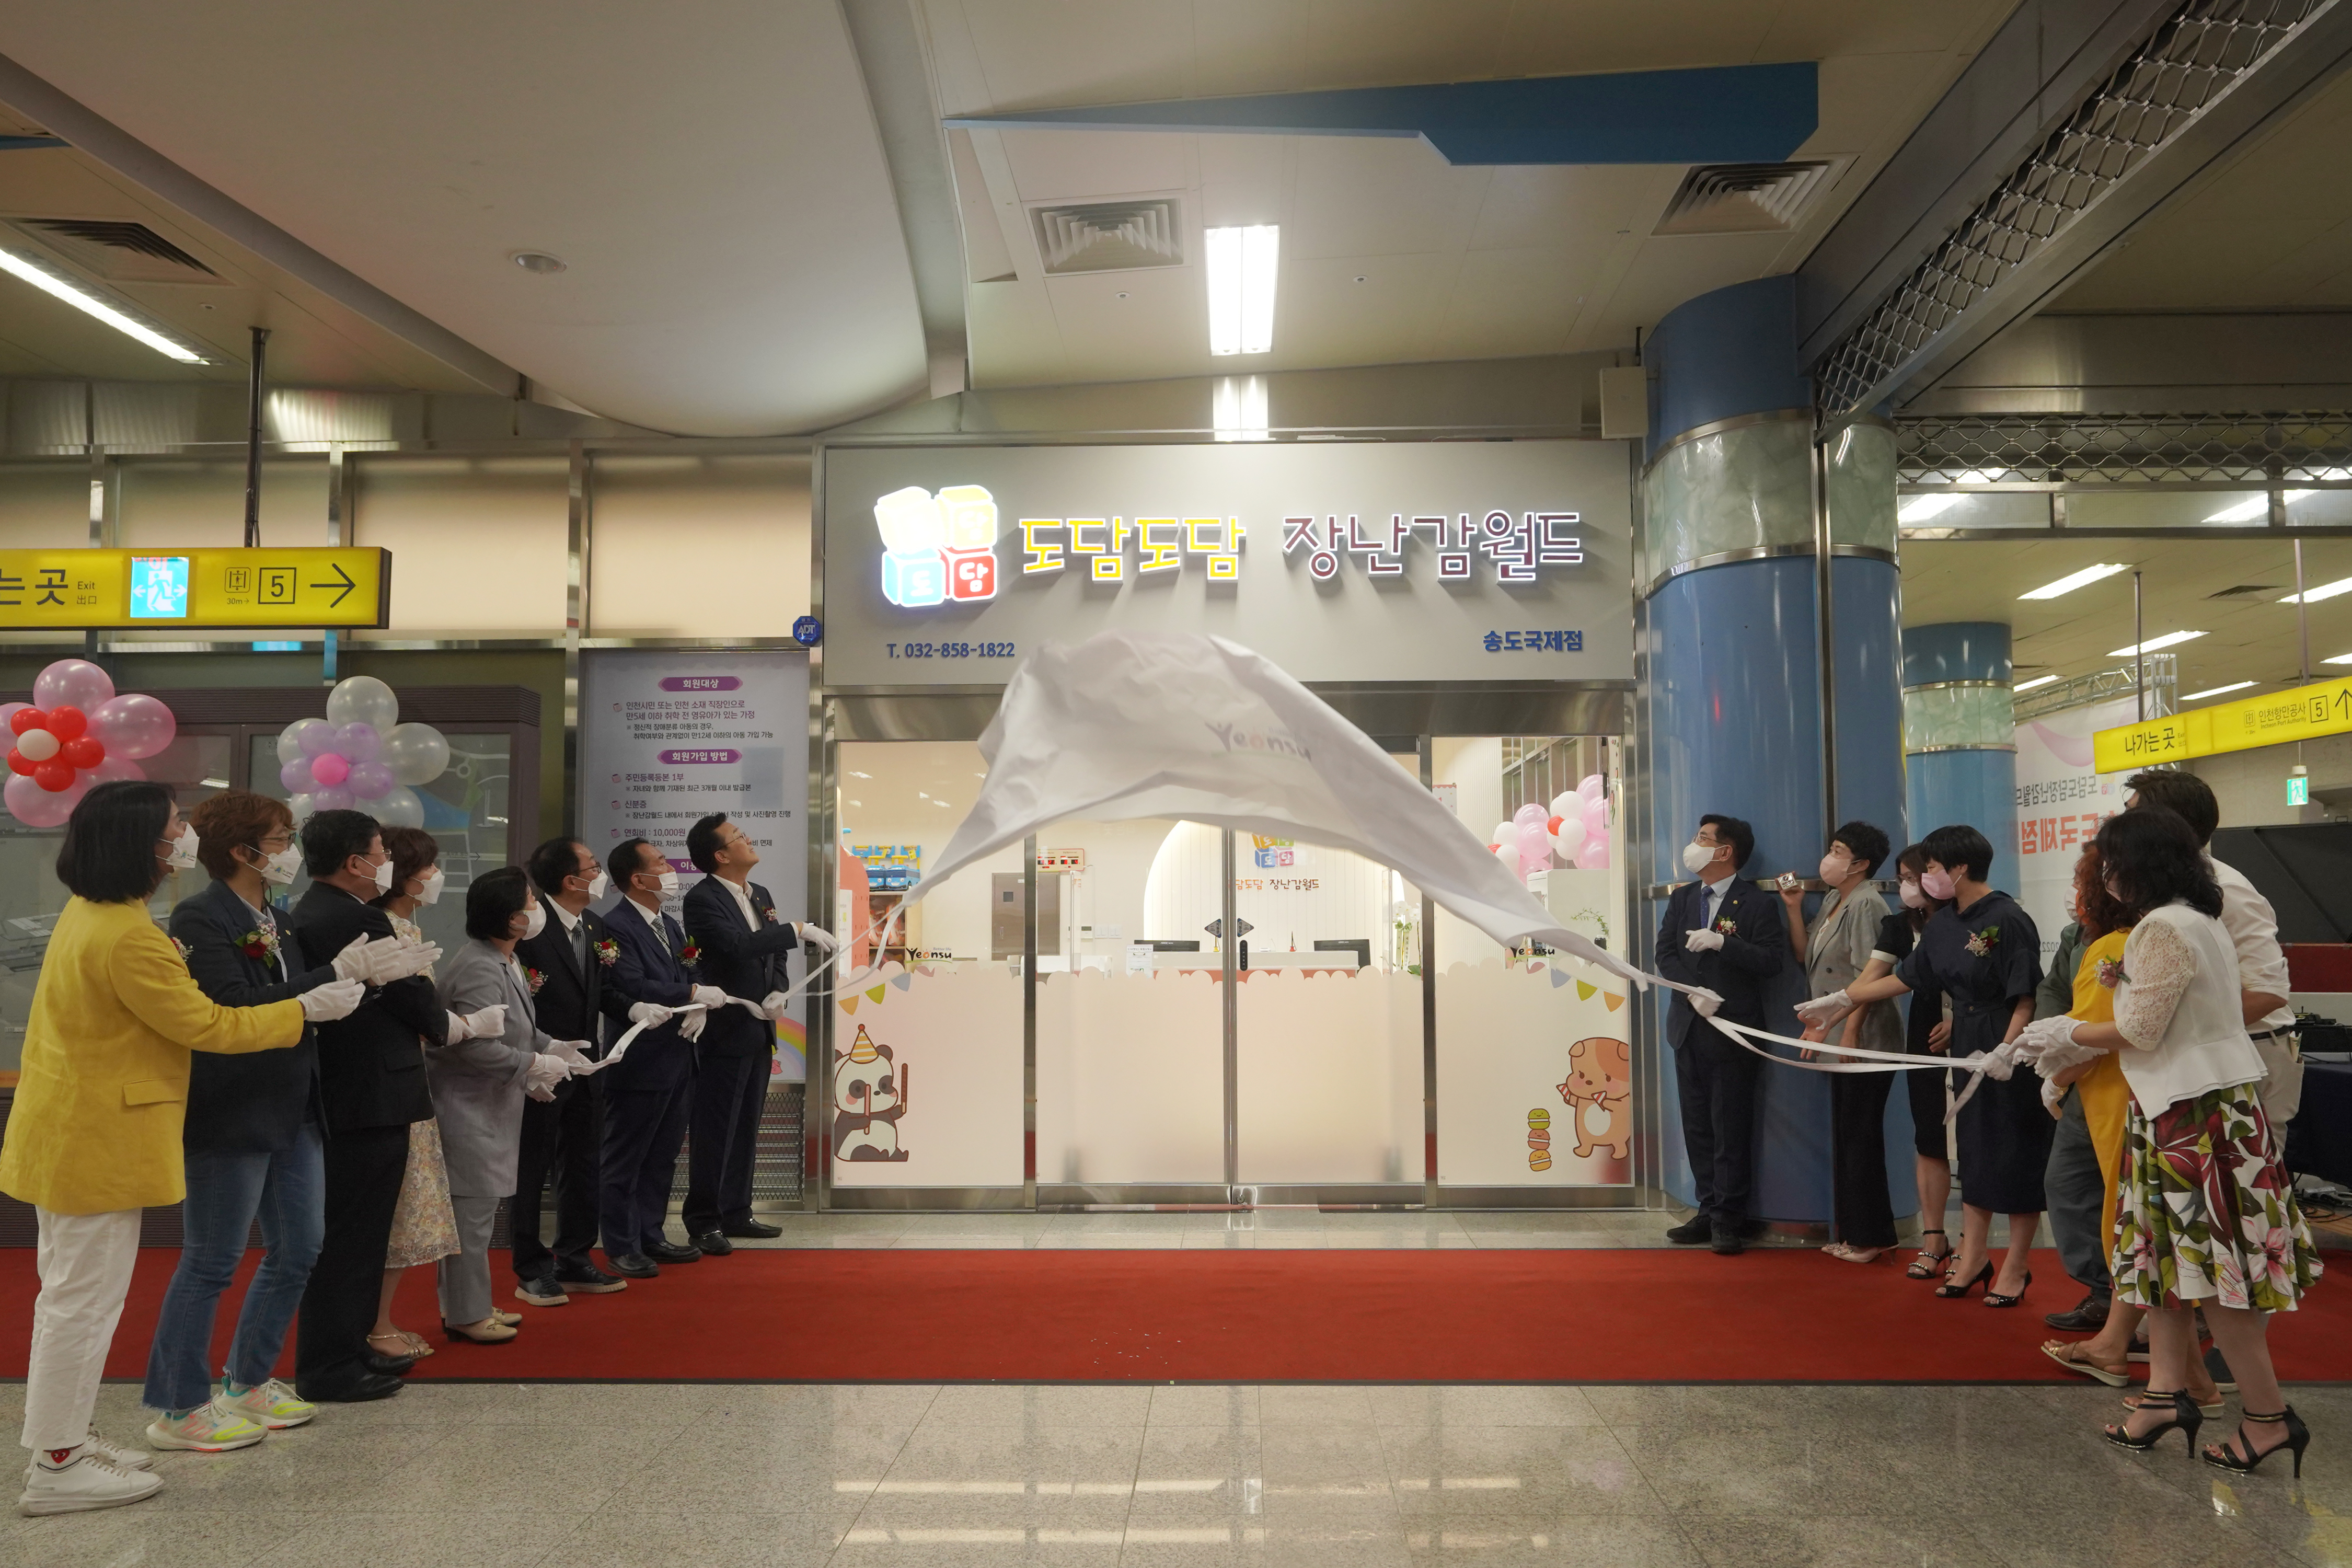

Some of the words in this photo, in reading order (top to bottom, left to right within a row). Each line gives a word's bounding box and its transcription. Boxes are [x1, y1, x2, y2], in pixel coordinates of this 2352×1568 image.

[1019, 515, 1247, 582] 도담도담
[1282, 510, 1584, 581] 장난감월드
[35, 569, 68, 606] 곳
[77, 581, 95, 590] Exit
[270, 575, 284, 597] 5
[76, 595, 97, 605] 出口
[798, 625, 815, 635] ADT
[1483, 629, 1583, 652] 송도국제점
[886, 643, 900, 659] T.
[905, 642, 1016, 659] 032-858-1822
[683, 678, 719, 689] 회원대상
[627, 701, 655, 710] 인천시민
[674, 701, 689, 709] 인천
[708, 700, 745, 709] 직장인으로
[626, 712, 646, 721] 만5세
[648, 712, 663, 720] 이하
[664, 711, 680, 720] 취학
[682, 711, 690, 720] 전
[691, 711, 721, 720] 영유아가
[723, 711, 738, 719] 있는
[740, 711, 755, 719] 가정
[2258, 702, 2307, 723] 인천항만공사
[2315, 702, 2323, 717] 5
[2125, 731, 2160, 756] 나가는
[2163, 727, 2175, 750] 곳
[672, 752, 708, 762] 회원가입
[710, 752, 728, 761] 방법
[625, 773, 670, 782] 주민등록등본
[672, 773, 685, 781] 1부
[625, 800, 647, 809] 신분증
[624, 828, 647, 837] 연회비
[653, 828, 686, 837] 10,000원
[1235, 879, 1263, 890] 담도담
[1269, 878, 1319, 891] 장난감월드
[905, 947, 951, 961] Yeonsu
[1510, 947, 1555, 958] Yeonsu
